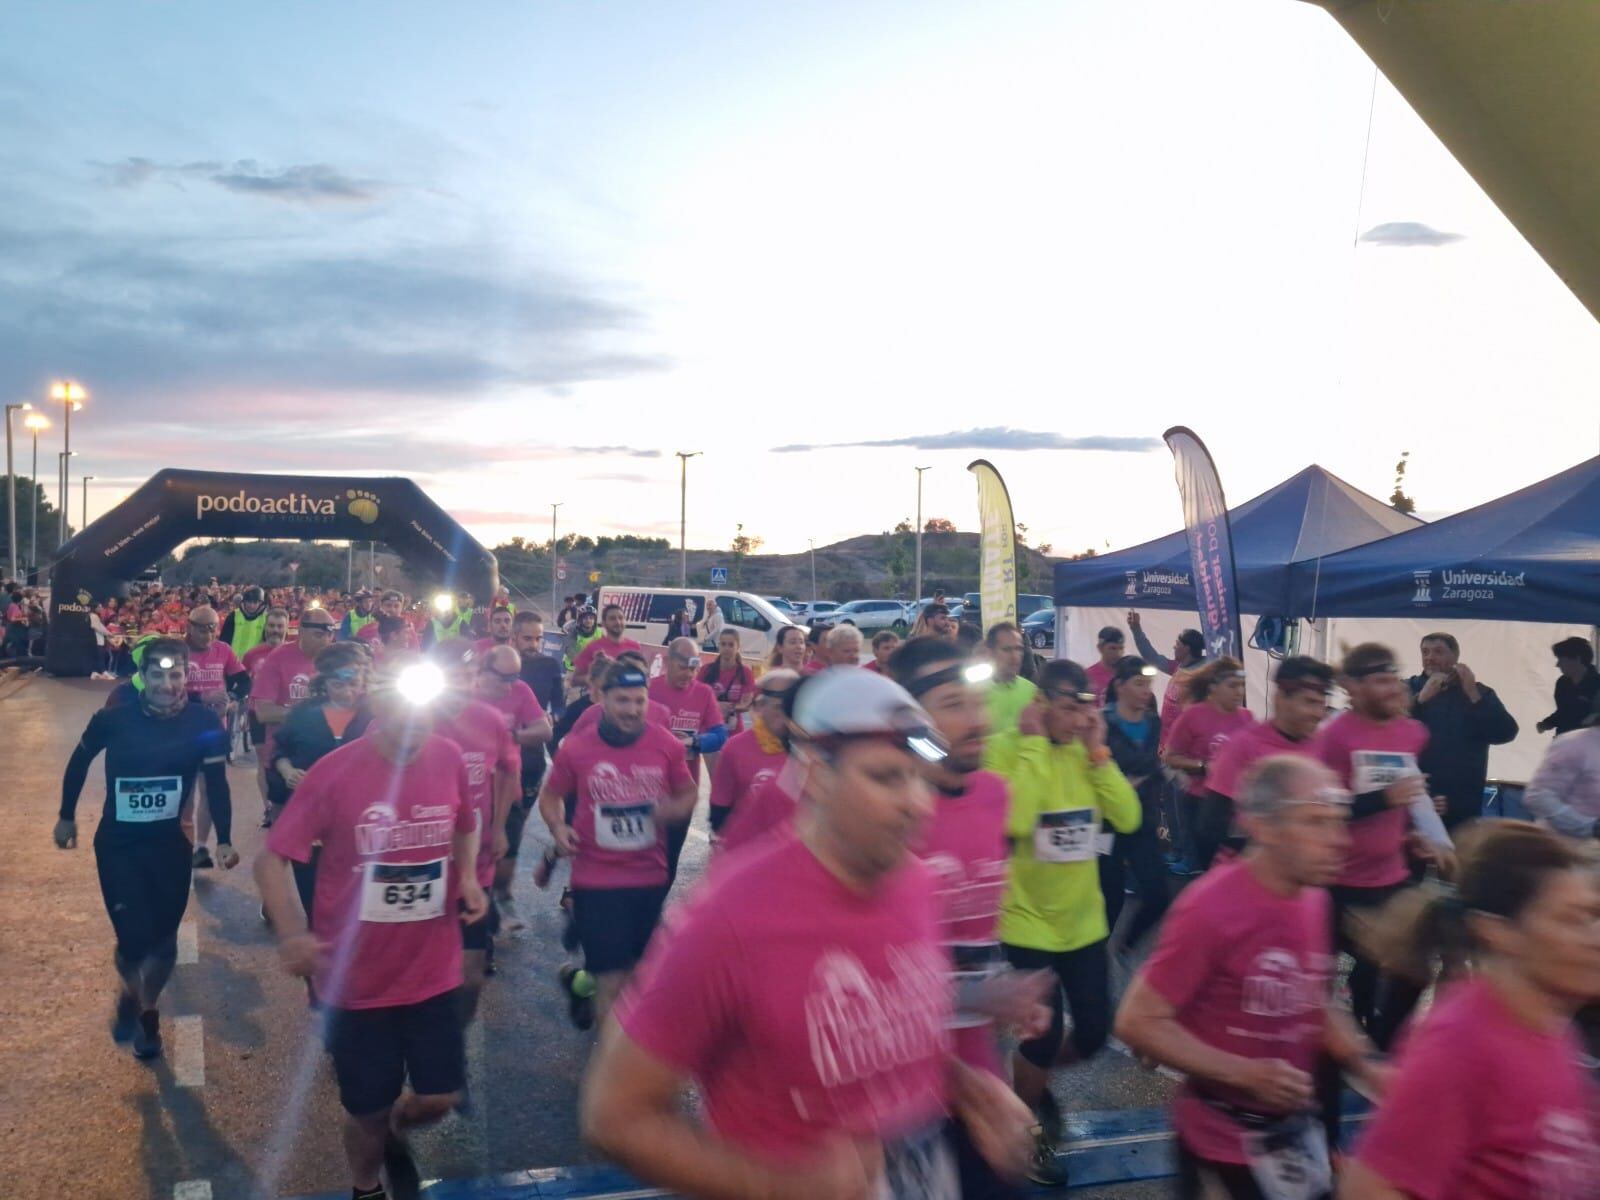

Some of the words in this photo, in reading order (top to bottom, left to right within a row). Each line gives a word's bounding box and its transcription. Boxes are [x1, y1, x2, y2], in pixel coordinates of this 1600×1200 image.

[197, 490, 336, 520] podoactiva
[1143, 570, 1190, 585] Universidad
[1441, 569, 1526, 587] Universidad
[1142, 583, 1172, 596] Zaragoza
[1441, 586, 1495, 602] Zaragoza
[128, 793, 167, 809] 508
[384, 882, 432, 905] 634
